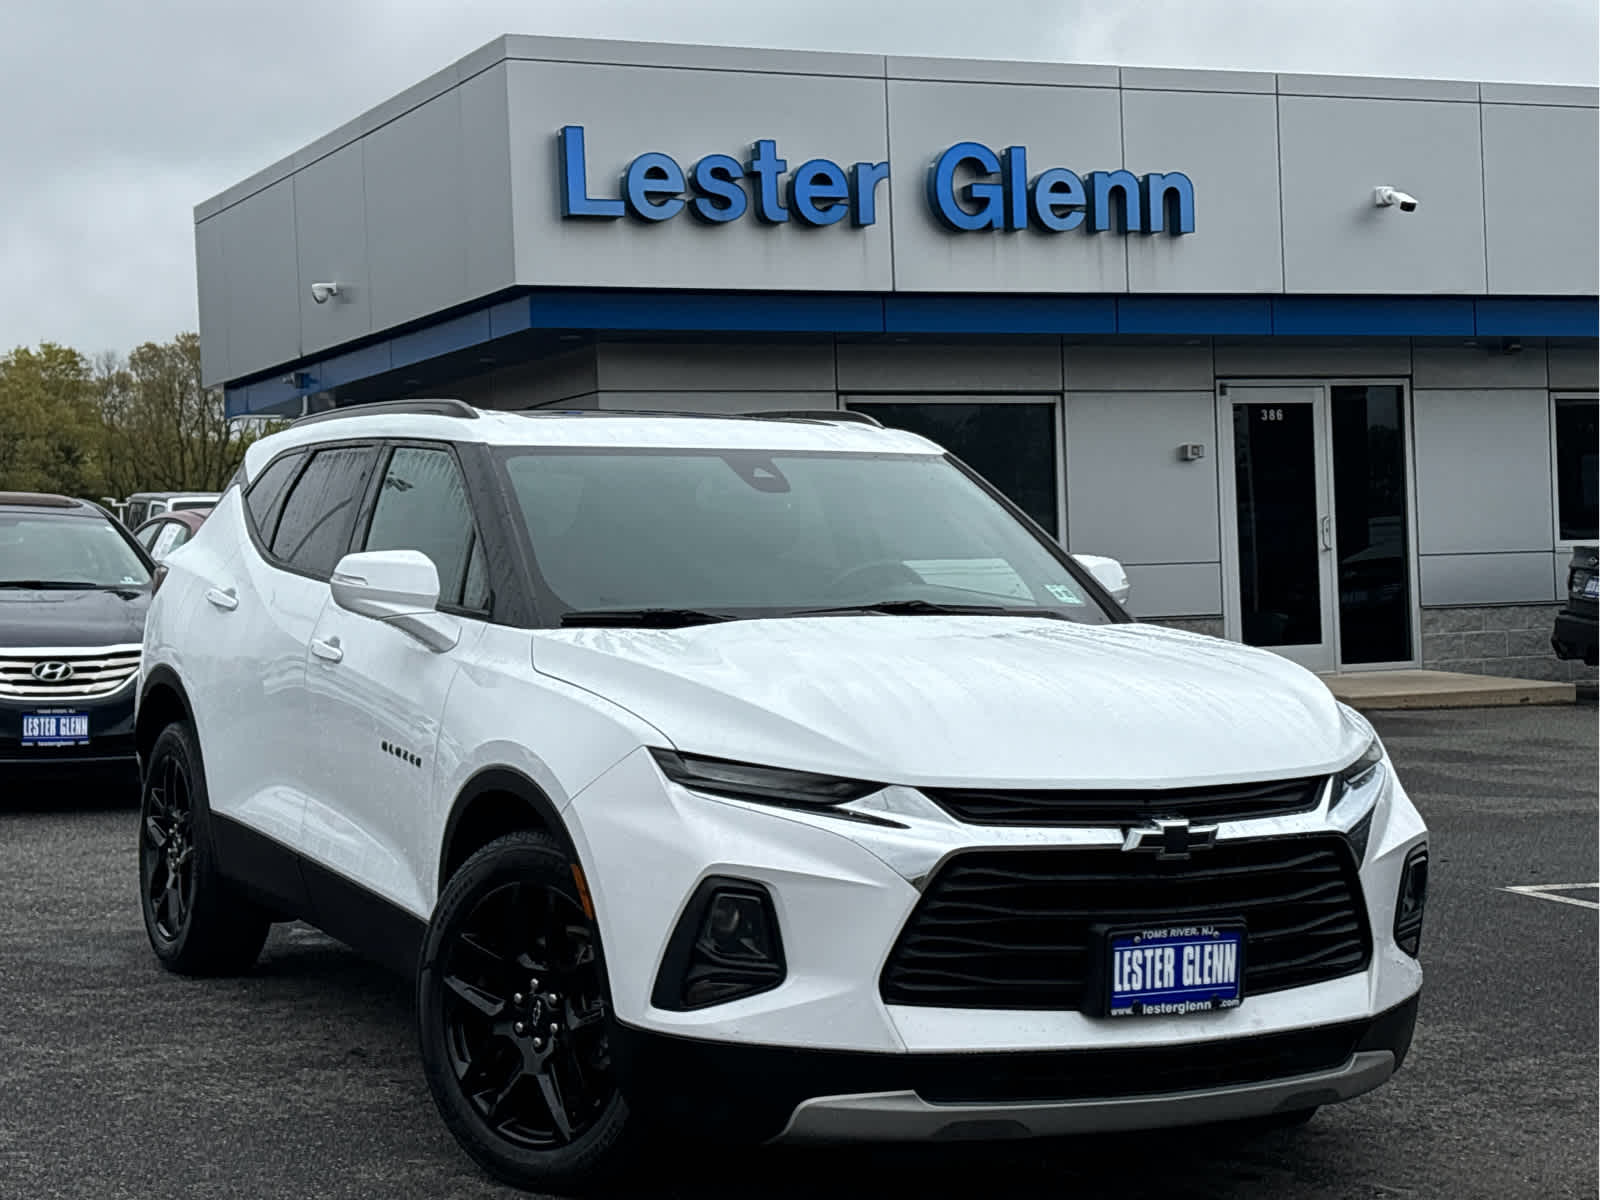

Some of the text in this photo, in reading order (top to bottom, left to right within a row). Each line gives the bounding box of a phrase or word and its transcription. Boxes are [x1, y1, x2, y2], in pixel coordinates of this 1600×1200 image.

[557, 125, 1196, 236] Lester Glenn
[1260, 408, 1283, 421] 386
[23, 715, 88, 737] LESTER GLENN
[1143, 930, 1168, 939] TOMS
[1201, 926, 1214, 936] NJ
[1114, 944, 1237, 991] LESTER GLENN
[1143, 1001, 1212, 1014] lesterglenn
